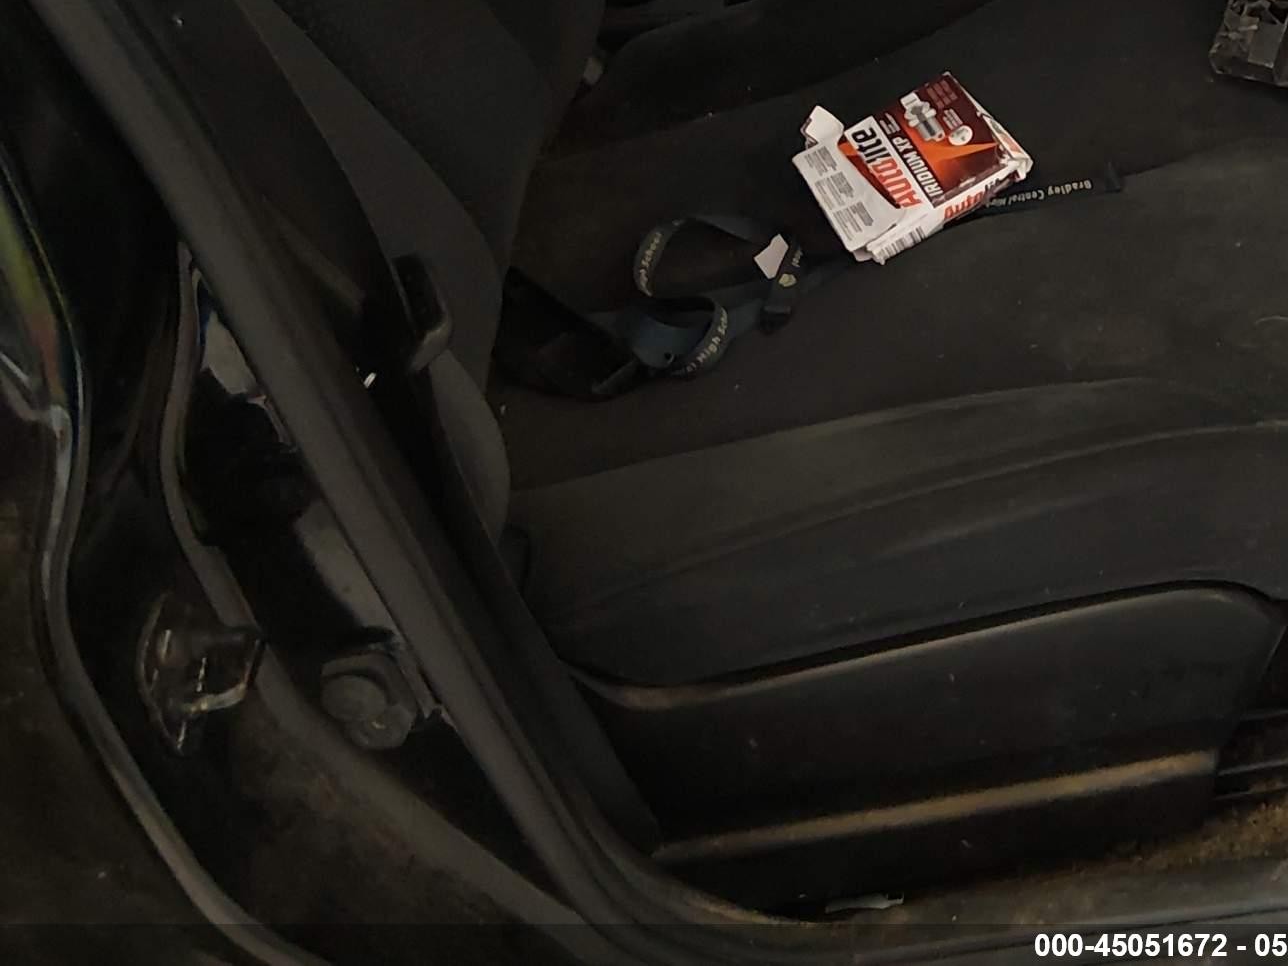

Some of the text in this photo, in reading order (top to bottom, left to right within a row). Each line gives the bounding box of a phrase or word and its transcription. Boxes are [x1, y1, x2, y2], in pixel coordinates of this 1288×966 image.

[891, 136, 944, 197] IRIDIUM XP
[1010, 188, 1045, 207] Central
[1046, 179, 1092, 197] Bradley
